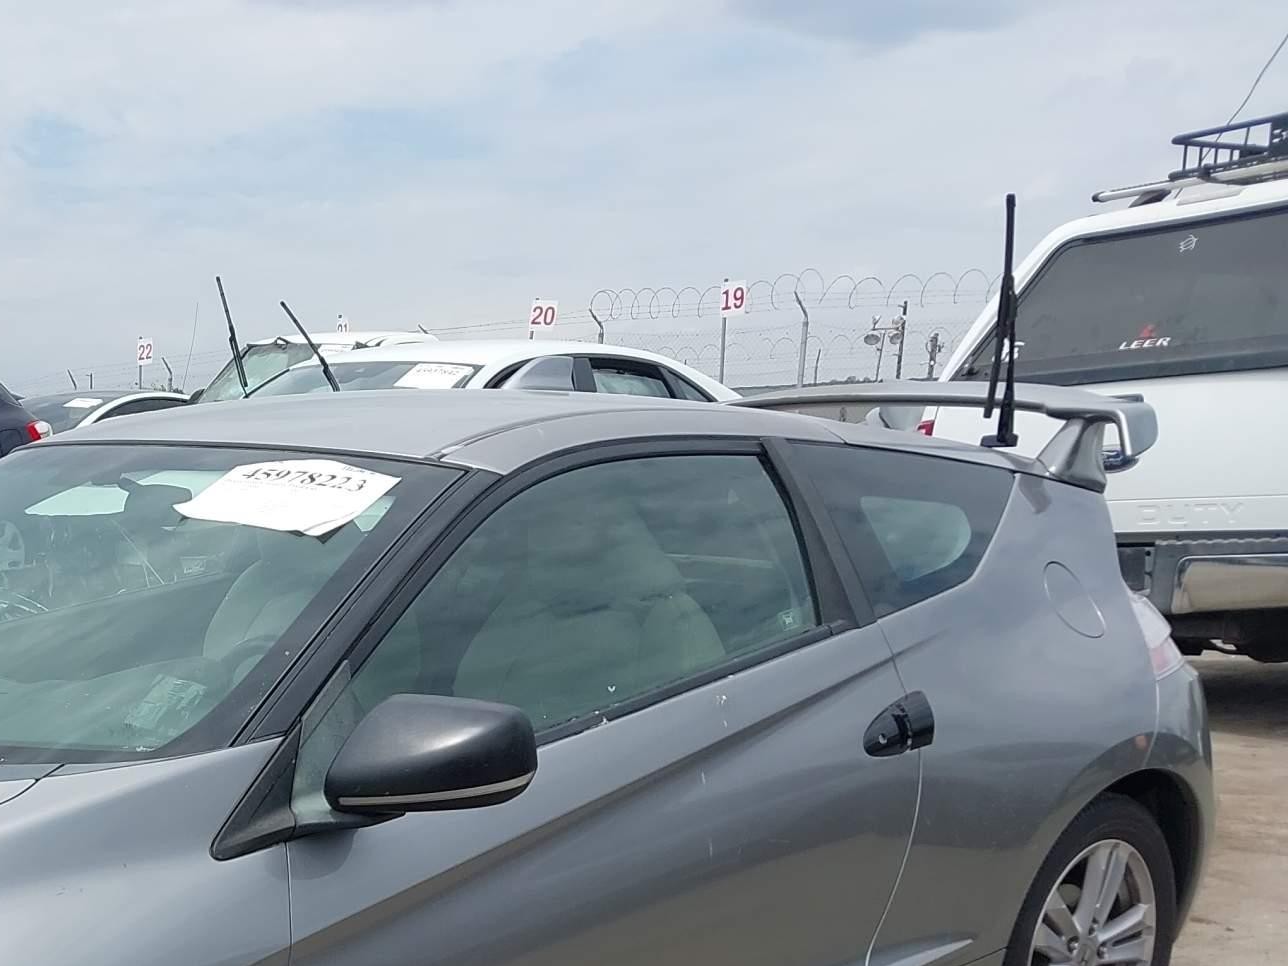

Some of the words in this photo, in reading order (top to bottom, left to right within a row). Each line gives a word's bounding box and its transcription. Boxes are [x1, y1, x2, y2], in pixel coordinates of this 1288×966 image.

[721, 286, 745, 311] 19
[530, 305, 556, 326] 20
[138, 343, 153, 361] 22
[1118, 336, 1171, 350] LEER
[241, 467, 367, 493] 45978223
